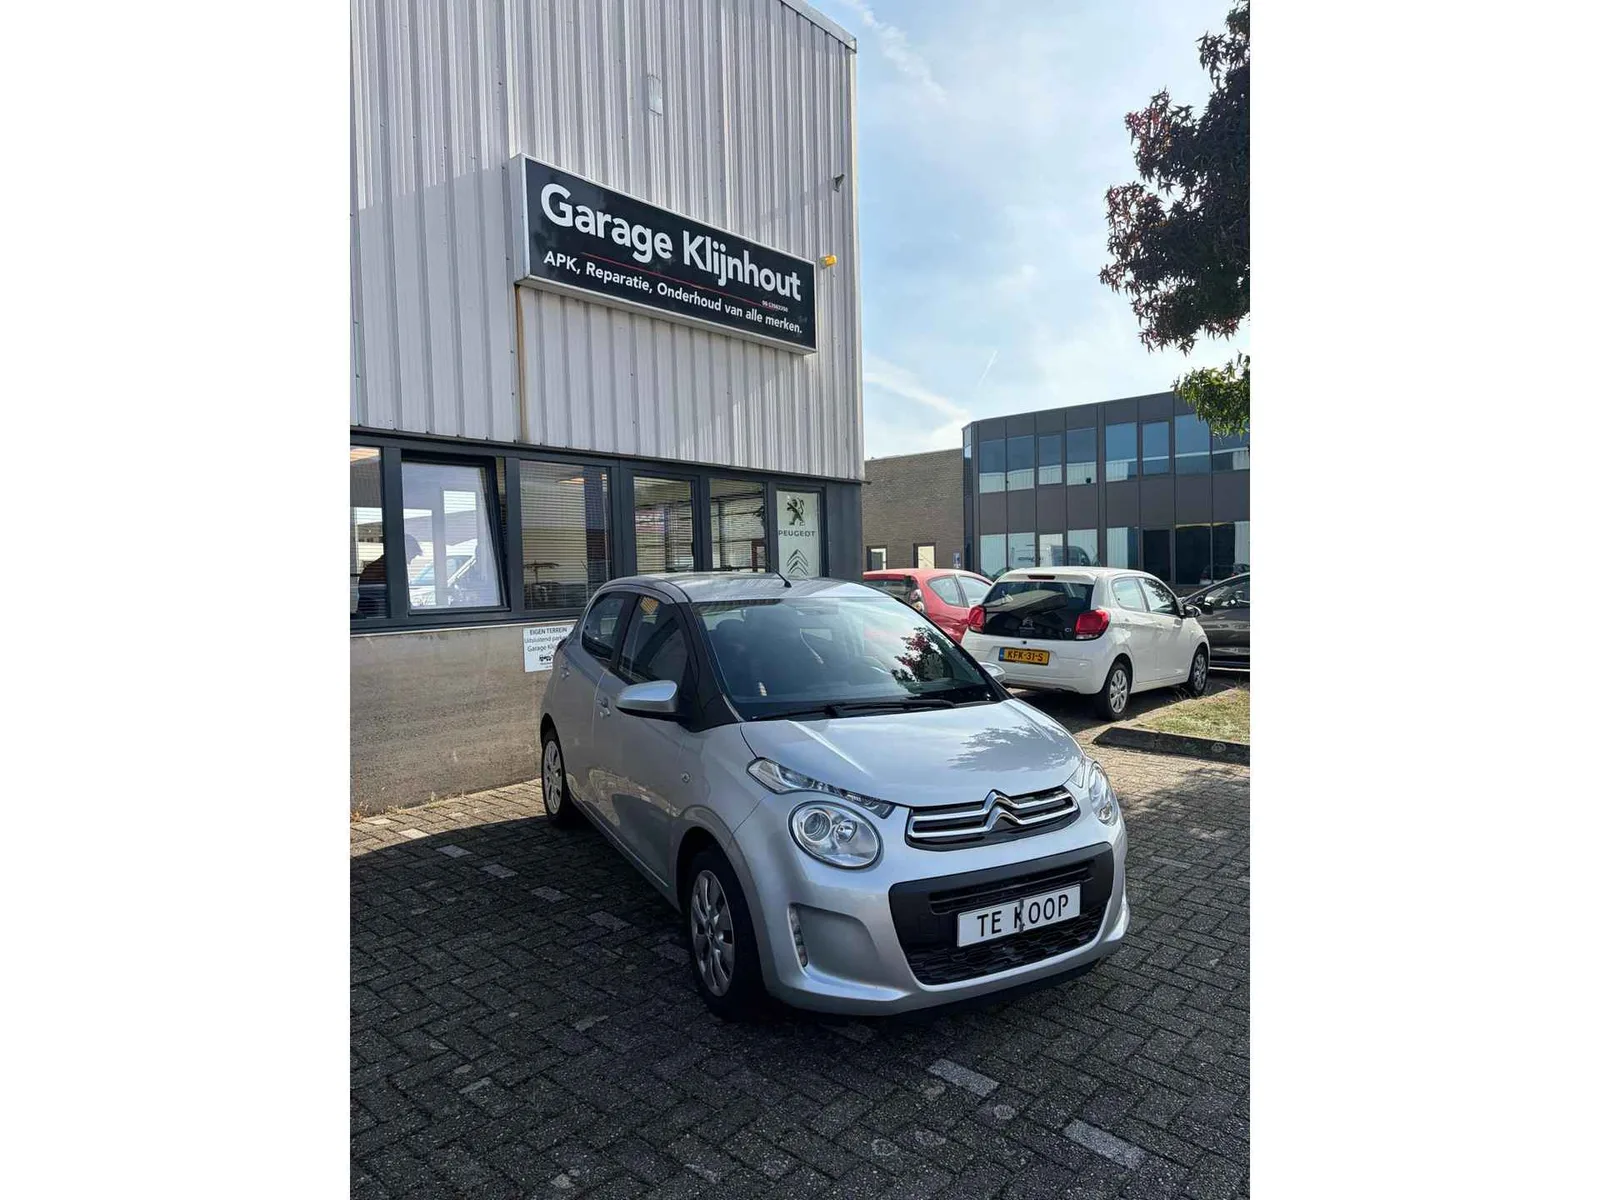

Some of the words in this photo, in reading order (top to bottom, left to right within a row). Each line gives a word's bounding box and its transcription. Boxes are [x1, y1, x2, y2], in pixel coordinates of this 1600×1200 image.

[540, 183, 673, 264] Garage
[682, 229, 801, 302] Klijnhout
[543, 250, 581, 275] APK,
[586, 261, 653, 295] Reparatie,
[657, 282, 722, 312] Onderhoud
[724, 303, 743, 318] van
[745, 308, 763, 323] alle
[765, 315, 803, 334] merken.
[778, 529, 816, 537] PEUGEOT
[1007, 650, 1044, 662] KFK-31-S
[976, 910, 1002, 937] TE
[1013, 894, 1069, 929] KOOP
